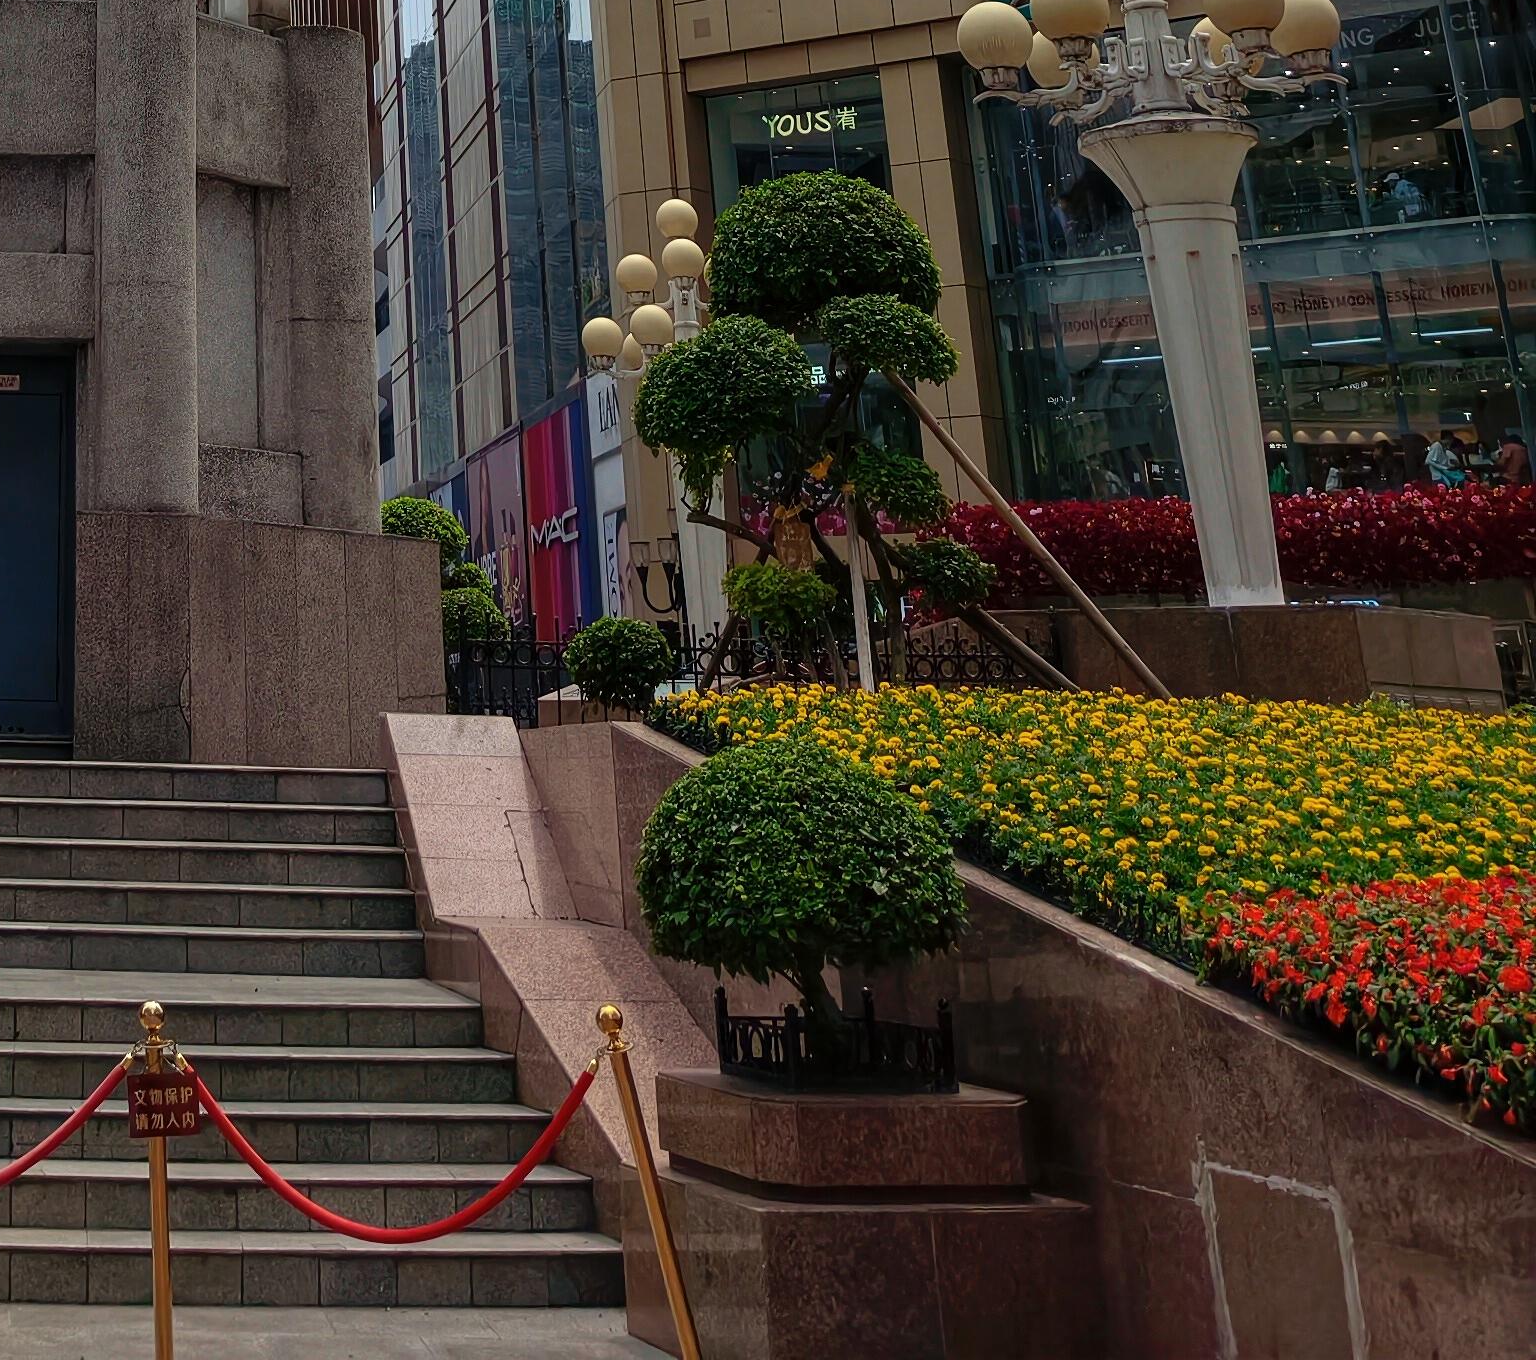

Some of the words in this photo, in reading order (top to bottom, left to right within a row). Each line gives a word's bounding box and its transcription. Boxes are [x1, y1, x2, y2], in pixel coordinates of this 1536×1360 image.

[762, 111, 831, 138] YOUS
[134, 1086, 194, 1107] 文物保护
